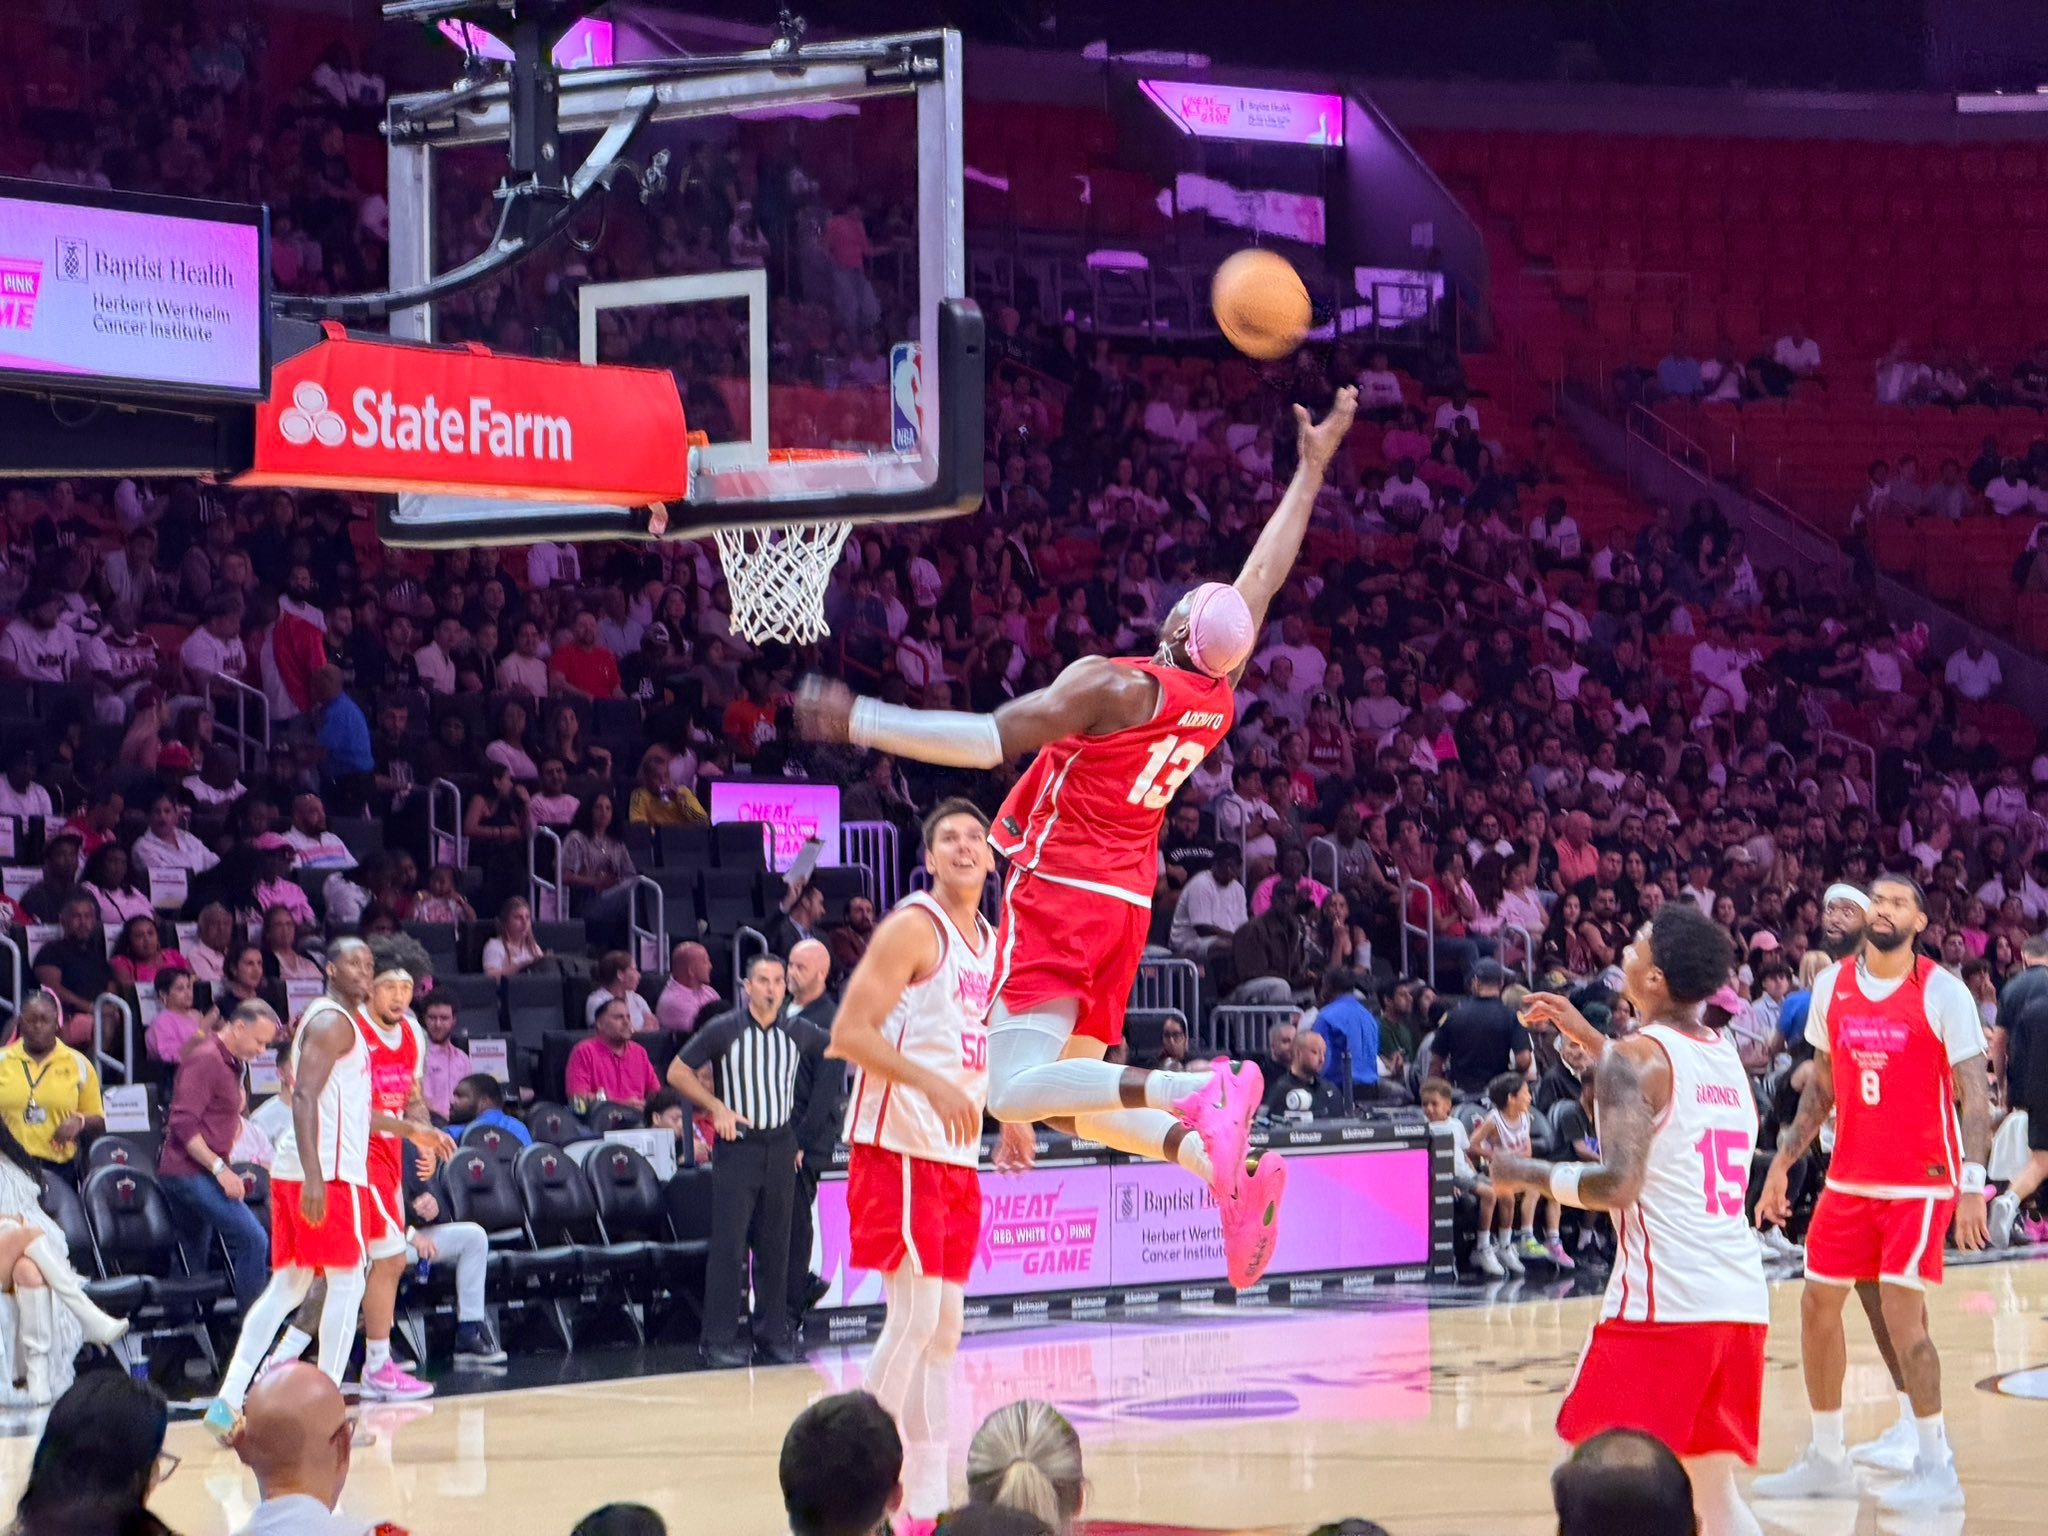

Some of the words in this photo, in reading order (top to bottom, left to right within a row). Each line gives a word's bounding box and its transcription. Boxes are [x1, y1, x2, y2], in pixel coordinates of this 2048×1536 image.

[3, 272, 35, 294] PINK
[95, 250, 163, 285] Baptist
[171, 258, 236, 289] Health
[93, 293, 152, 316] Herbert
[93, 314, 147, 337] Cancer
[150, 320, 213, 343] Institute
[896, 427, 915, 446] NBA
[1126, 733, 1206, 809] 13
[961, 1031, 986, 1072] 50
[1696, 1083, 1742, 1108] GARDNER
[1860, 1069, 1881, 1105] 8
[1694, 1127, 1749, 1216] 15
[994, 1191, 1060, 1220] HEAT
[1144, 1187, 1194, 1217] Baptist
[993, 1228, 1015, 1245] RED,
[1015, 1225, 1046, 1243] WHITE
[1069, 1223, 1092, 1240] PINK
[1142, 1226, 1186, 1244] Herbert
[1189, 1225, 1224, 1242] Werth
[1023, 1248, 1092, 1275] GAME
[1142, 1247, 1180, 1264] Cancer
